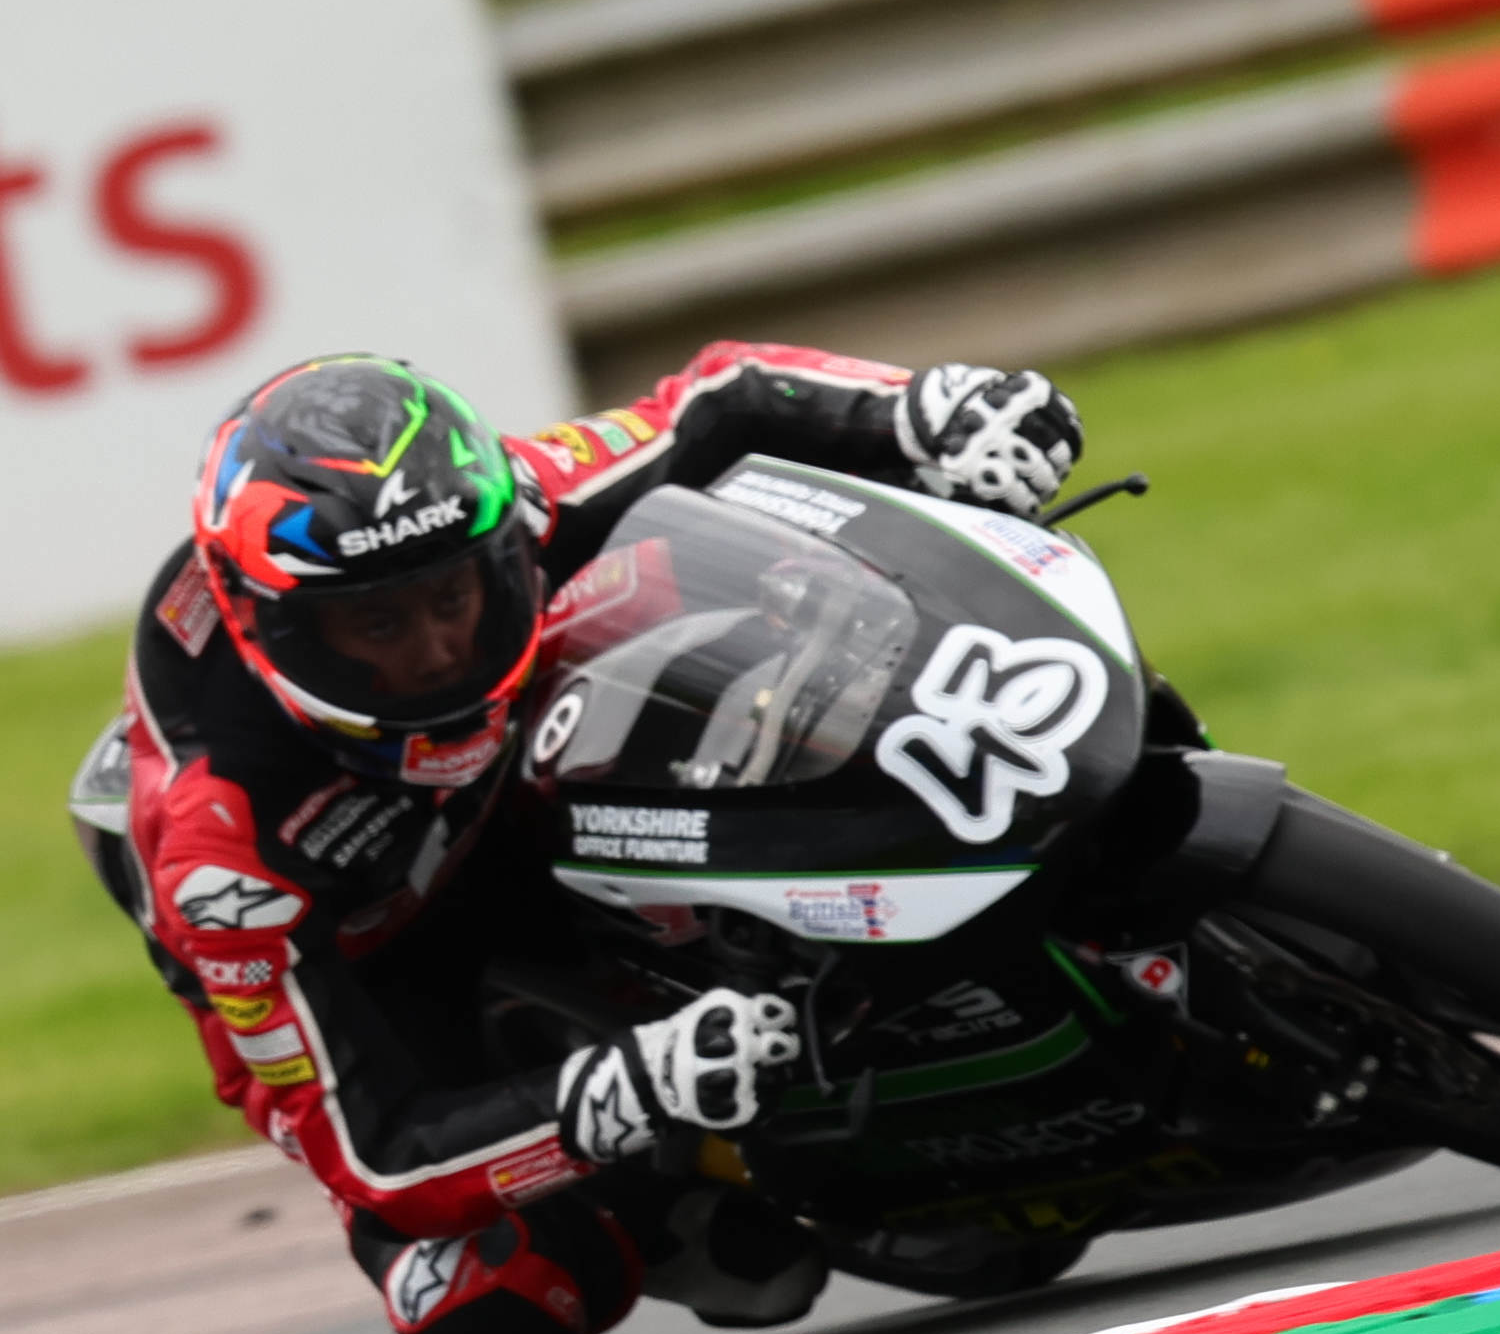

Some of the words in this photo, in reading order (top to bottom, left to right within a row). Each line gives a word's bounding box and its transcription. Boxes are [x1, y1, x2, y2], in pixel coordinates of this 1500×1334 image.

[337, 495, 468, 557] SHARK
[877, 624, 1109, 844] 43
[570, 803, 711, 838] YORKSHIRE
[573, 835, 621, 857] OFFICE
[624, 837, 710, 864] FURNITURE
